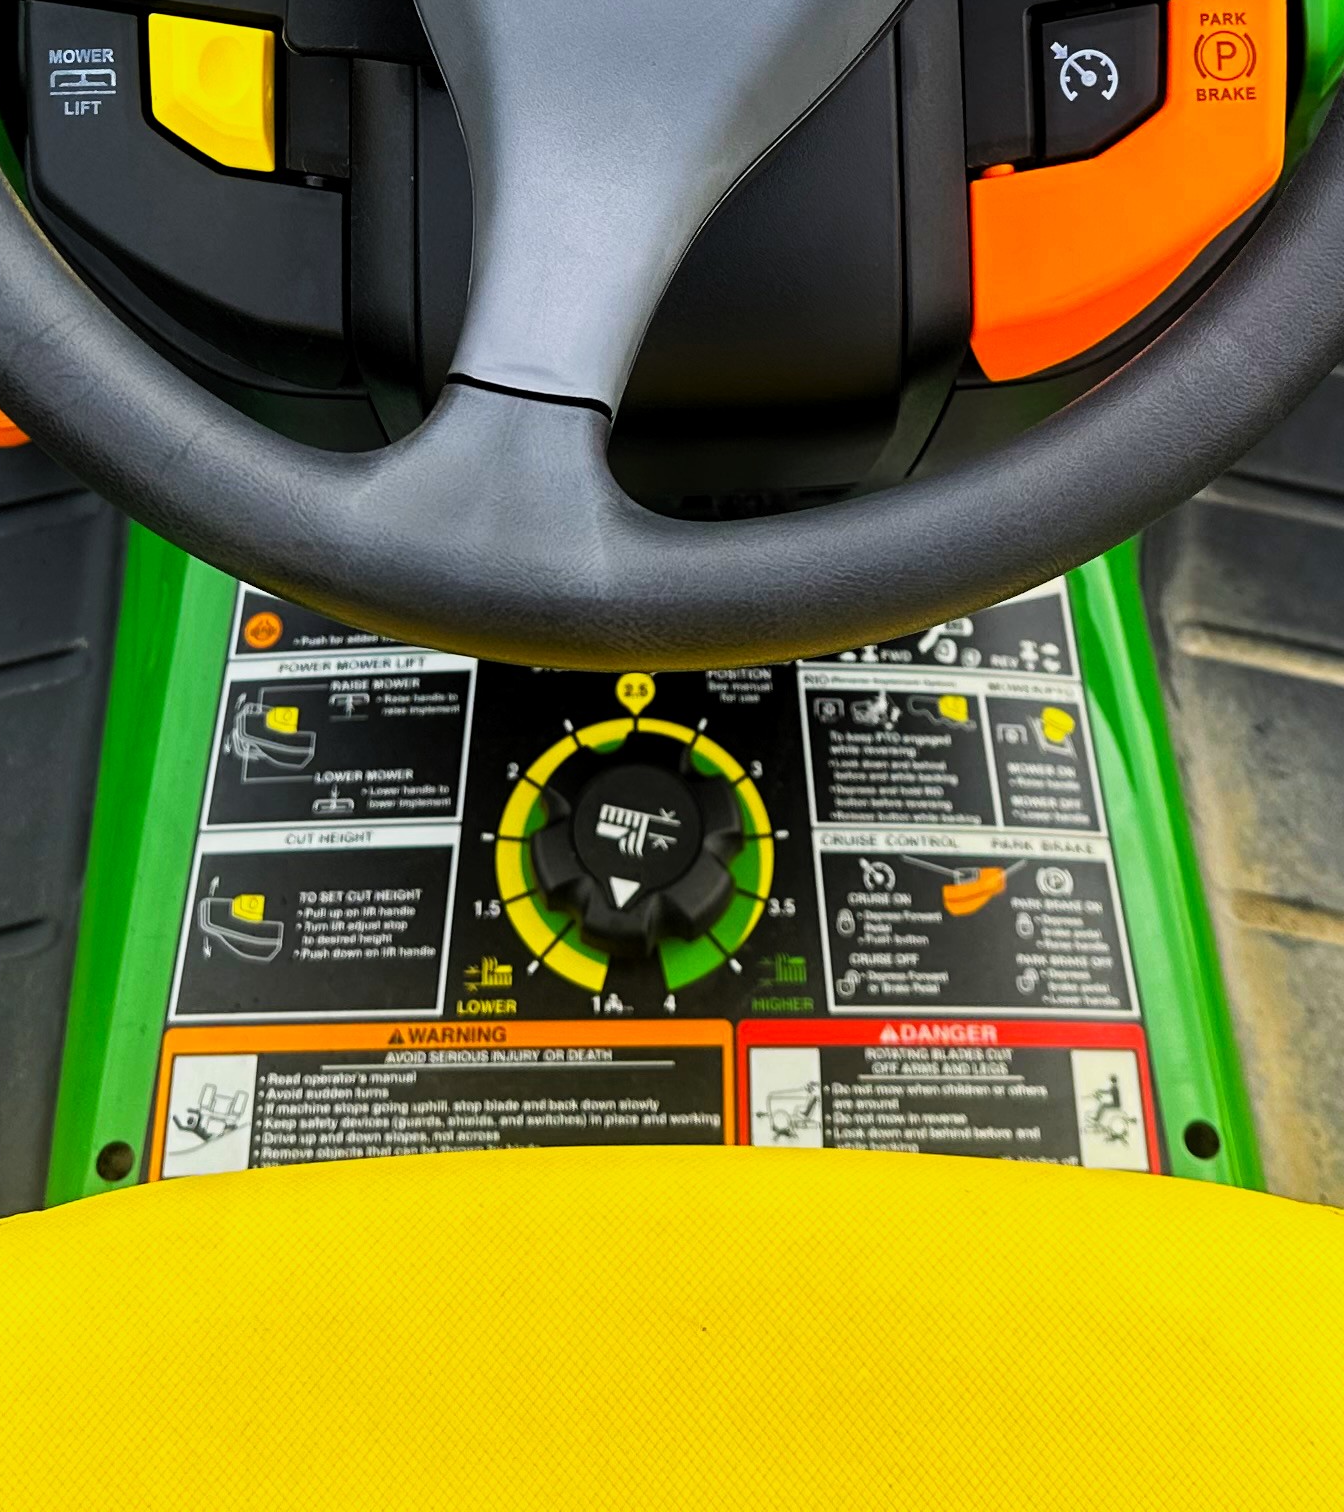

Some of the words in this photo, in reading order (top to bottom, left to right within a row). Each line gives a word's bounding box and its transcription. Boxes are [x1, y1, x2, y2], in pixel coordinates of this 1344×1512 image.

[1200, 12, 1246, 26] PARK
[48, 48, 115, 64] MOWER
[1216, 42, 1237, 71] P
[1196, 86, 1257, 102] BRAKE
[64, 100, 102, 115] LIFT
[279, 660, 332, 673] POWER
[336, 658, 391, 671] MOWER
[396, 657, 426, 669] LIFT
[330, 679, 370, 692] RAISE
[373, 677, 421, 690] MOWER
[623, 682, 649, 699] 2.5
[313, 769, 363, 784] LOWER
[364, 768, 414, 782] MOWER
[507, 762, 520, 780] 2
[285, 833, 314, 845] CUT
[319, 831, 374, 844] HEIGHT
[820, 831, 878, 848] CRUISE
[884, 833, 960, 850] CONTROL
[990, 838, 1034, 852] PARK
[1040, 840, 1096, 855] BRAKE
[299, 890, 318, 904] TO
[344, 889, 374, 903] CUT
[473, 900, 502, 919] 1.5
[767, 899, 796, 918] 3.5
[457, 998, 517, 1014] LOWER
[663, 994, 677, 1014] 4
[751, 996, 815, 1012] HIGHER
[408, 1027, 506, 1043] WARNING
[899, 1023, 998, 1042] DANGER
[384, 1050, 427, 1064] AVOID
[428, 1050, 490, 1063] SERIOUS
[491, 1049, 541, 1062] INJURY
[542, 1049, 565, 1062] OR
[566, 1048, 613, 1061] DEATH
[864, 1047, 930, 1061] ROTATING
[930, 1047, 984, 1062] BLADES
[985, 1047, 1013, 1062] CUT
[900, 1061, 940, 1075] ARMS
[266, 1072, 302, 1086] Read
[369, 1071, 417, 1084] manual
[265, 1087, 304, 1101] Avoid
[306, 1087, 353, 1100] sudden
[354, 1087, 390, 1099] turns
[274, 1101, 332, 1116] machine
[334, 1101, 370, 1116] stops
[371, 1101, 409, 1117] going
[451, 1098, 483, 1115] stop
[483, 1098, 521, 1113] blade
[522, 1098, 547, 1112] and
[547, 1098, 578, 1112] back
[579, 1097, 617, 1111] down
[618, 1097, 660, 1112] slowly
[263, 1117, 297, 1131] Keep
[298, 1116, 339, 1131] safety
[340, 1116, 390, 1130] devices
[499, 1113, 525, 1126] and
[641, 1112, 667, 1125] and
[668, 1111, 721, 1127] working
[261, 1130, 298, 1144] Drive
[299, 1132, 317, 1146] up
[318, 1131, 344, 1143] and
[345, 1130, 382, 1143] down
[432, 1129, 455, 1142] not
[455, 1130, 500, 1142] across
[261, 1146, 314, 1160] Remove
